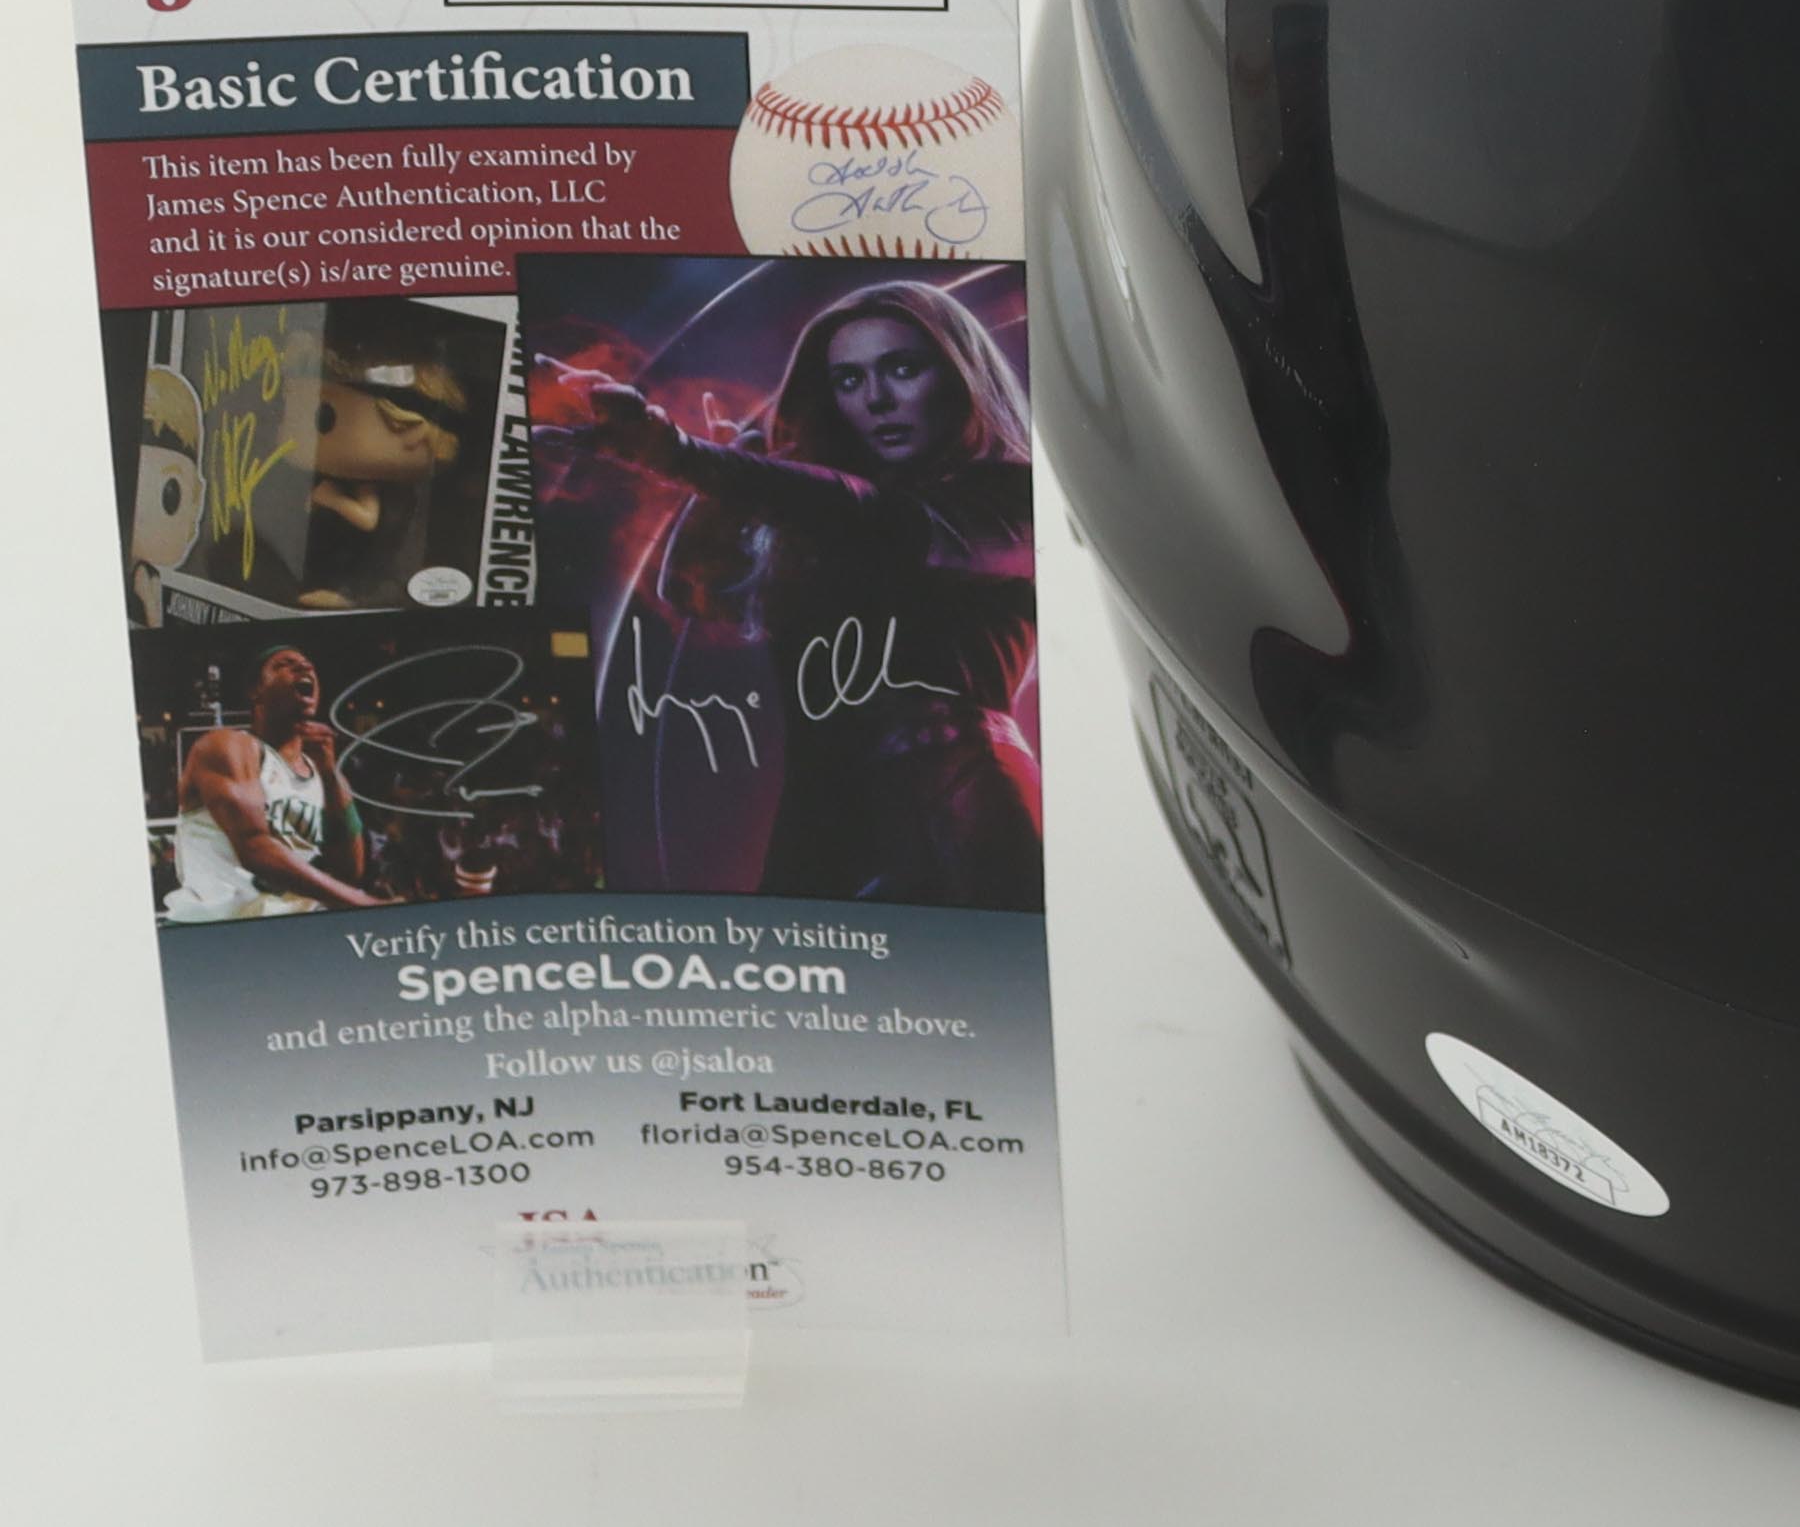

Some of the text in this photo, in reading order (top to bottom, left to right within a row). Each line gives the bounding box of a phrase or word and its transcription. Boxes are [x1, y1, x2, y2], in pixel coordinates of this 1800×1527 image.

[136, 50, 695, 112] Basic Certification
[142, 141, 636, 179] This item has been fully examined by
[146, 180, 606, 220] James Spence Authentication, LLC
[150, 215, 680, 254] and it is our considered opinion that the
[153, 255, 511, 298] signature(s) is/are genuine.
[346, 915, 890, 960] Verify this certification by visiting
[398, 953, 847, 1005] SpenceLOA.com
[267, 1000, 976, 1052] and entering the alpha-numeric value above.
[486, 1048, 774, 1079] Follow us @jsaloa
[295, 1096, 534, 1135] Parsippany, NJ
[679, 1091, 983, 1121] Fort Lauderdale, FL
[240, 1127, 595, 1173] info@SpenceLOA.com
[640, 1123, 1024, 1153] florida@SpenceLOA.com
[1499, 1118, 1586, 1184] AM18372
[310, 1161, 531, 1199] 973-898-1300
[724, 1155, 946, 1182] 954-380-8670
